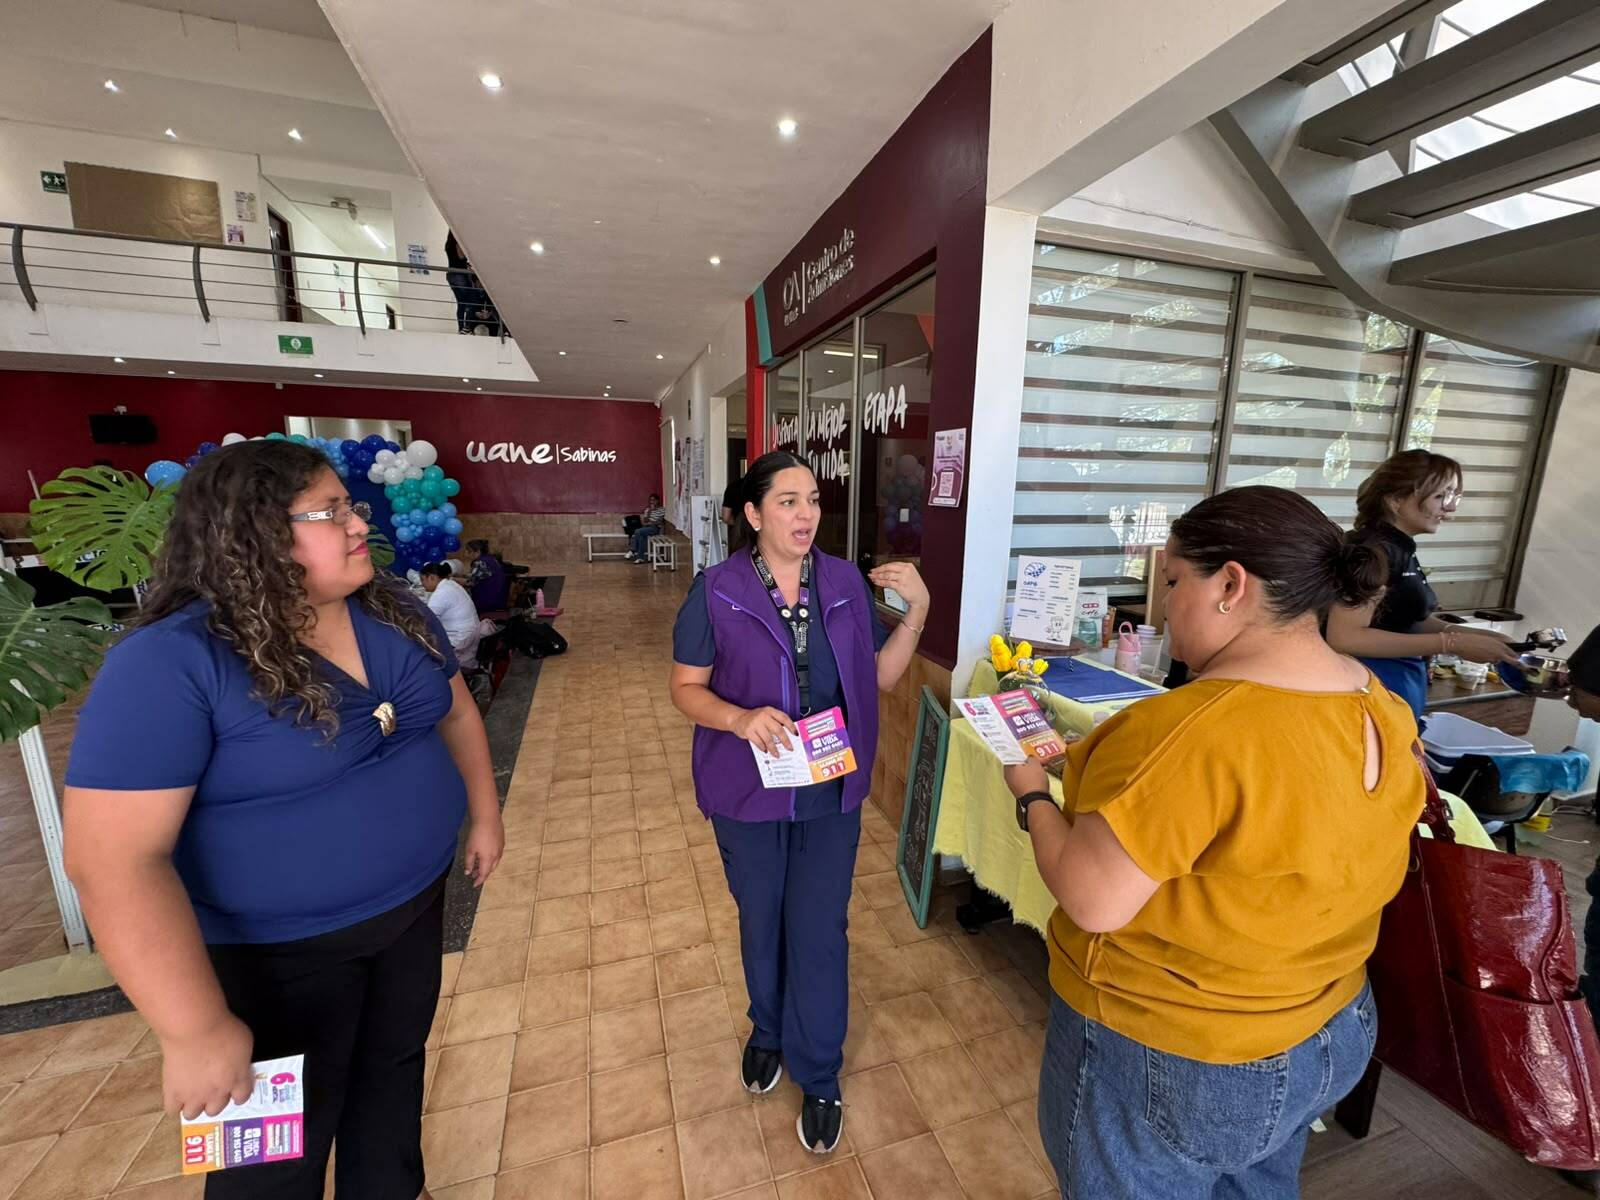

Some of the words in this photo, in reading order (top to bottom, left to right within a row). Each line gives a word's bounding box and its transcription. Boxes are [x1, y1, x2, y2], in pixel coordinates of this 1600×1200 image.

[839, 228, 855, 255] de
[817, 402, 848, 449] MEJOR
[864, 384, 908, 435] ETAPA
[466, 440, 553, 465] uane
[560, 446, 617, 463] Sabinas
[821, 448, 851, 487] VIDA
[1036, 743, 1060, 757] 911
[822, 761, 845, 777] 911
[270, 1072, 296, 1085] 6
[186, 1135, 203, 1163] 911
[243, 1139, 253, 1159] VIDA
